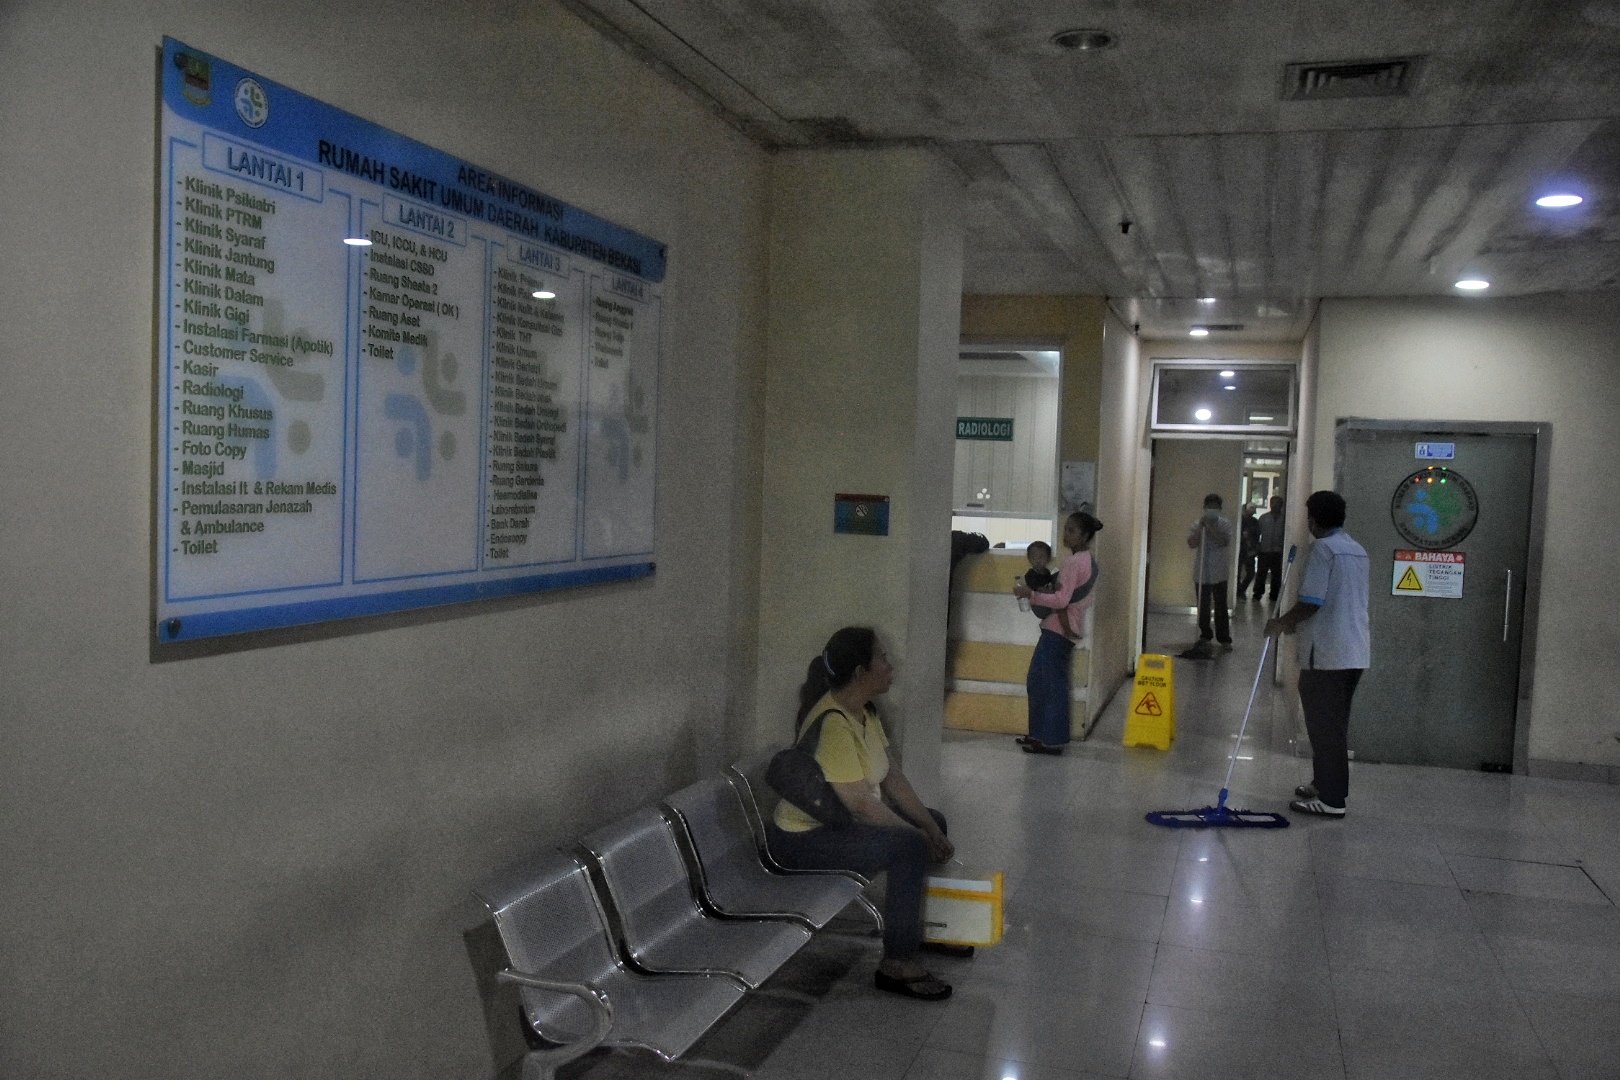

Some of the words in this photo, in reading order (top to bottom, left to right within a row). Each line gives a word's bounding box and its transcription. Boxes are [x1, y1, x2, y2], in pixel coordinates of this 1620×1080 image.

[227, 146, 291, 188] LANTAI
[296, 169, 303, 192] 1
[185, 176, 222, 200] Klinik
[226, 188, 275, 215] Psikiatri
[319, 141, 384, 185] RUMAH
[389, 167, 436, 203] SAKIT
[440, 186, 484, 220] UMUM
[487, 203, 536, 238] DAERAH
[457, 164, 495, 197] AREA
[498, 180, 563, 223] INFORMASI
[184, 196, 222, 220] Klinik
[225, 207, 261, 230] PTRM
[399, 204, 444, 236] LANTAI
[447, 220, 454, 239] 2
[184, 217, 222, 240] Klinik
[225, 227, 266, 253] Syaraf
[370, 229, 390, 249] ICU,
[392, 236, 418, 257] ICCU,
[420, 244, 427, 257] &
[428, 246, 447, 263] HCU
[184, 237, 222, 259] Klinik
[224, 247, 274, 274] Jantung
[369, 248, 408, 270] Instalasi
[519, 244, 554, 270] LANTAI
[555, 256, 560, 272] 3
[184, 258, 221, 279] Klinik
[225, 267, 255, 286] Mata
[369, 268, 399, 289] Ruang
[432, 283, 437, 296] 2
[184, 278, 221, 299] Klinik
[224, 286, 263, 307] Dalam
[369, 287, 400, 305] Kamar
[401, 294, 434, 315] Operasi
[183, 299, 221, 319] Klinik
[224, 306, 249, 327] Gigi
[368, 306, 398, 326] Ruang
[400, 312, 420, 328] Aset
[183, 319, 238, 341] Instalasi
[241, 328, 288, 348] Farmasi
[290, 336, 333, 358] (Apotik)
[368, 325, 400, 342] Komite
[183, 340, 246, 361] Customer
[249, 349, 293, 367] Service
[368, 344, 393, 360] Toilet
[183, 360, 219, 378] Kasir
[182, 380, 243, 403] Radiologi
[182, 401, 224, 420] Ruang
[228, 404, 273, 421] Khusus
[182, 421, 224, 440] Ruang
[228, 424, 269, 439] Humas
[958, 423, 1011, 437] RADIOLOGI
[182, 441, 211, 455] Foto
[214, 442, 246, 460] Copy
[181, 461, 224, 478] Masjid
[181, 481, 236, 495] Instalasi
[253, 482, 262, 494] &
[265, 482, 303, 494] Rekam
[305, 482, 336, 494] Medis
[181, 500, 263, 515] Pemulasaran
[265, 500, 312, 513] Jenazah
[180, 521, 191, 535] &
[194, 519, 264, 534] Ambulance
[181, 540, 217, 555] Toilet
[1415, 552, 1455, 563] BAHAYA
